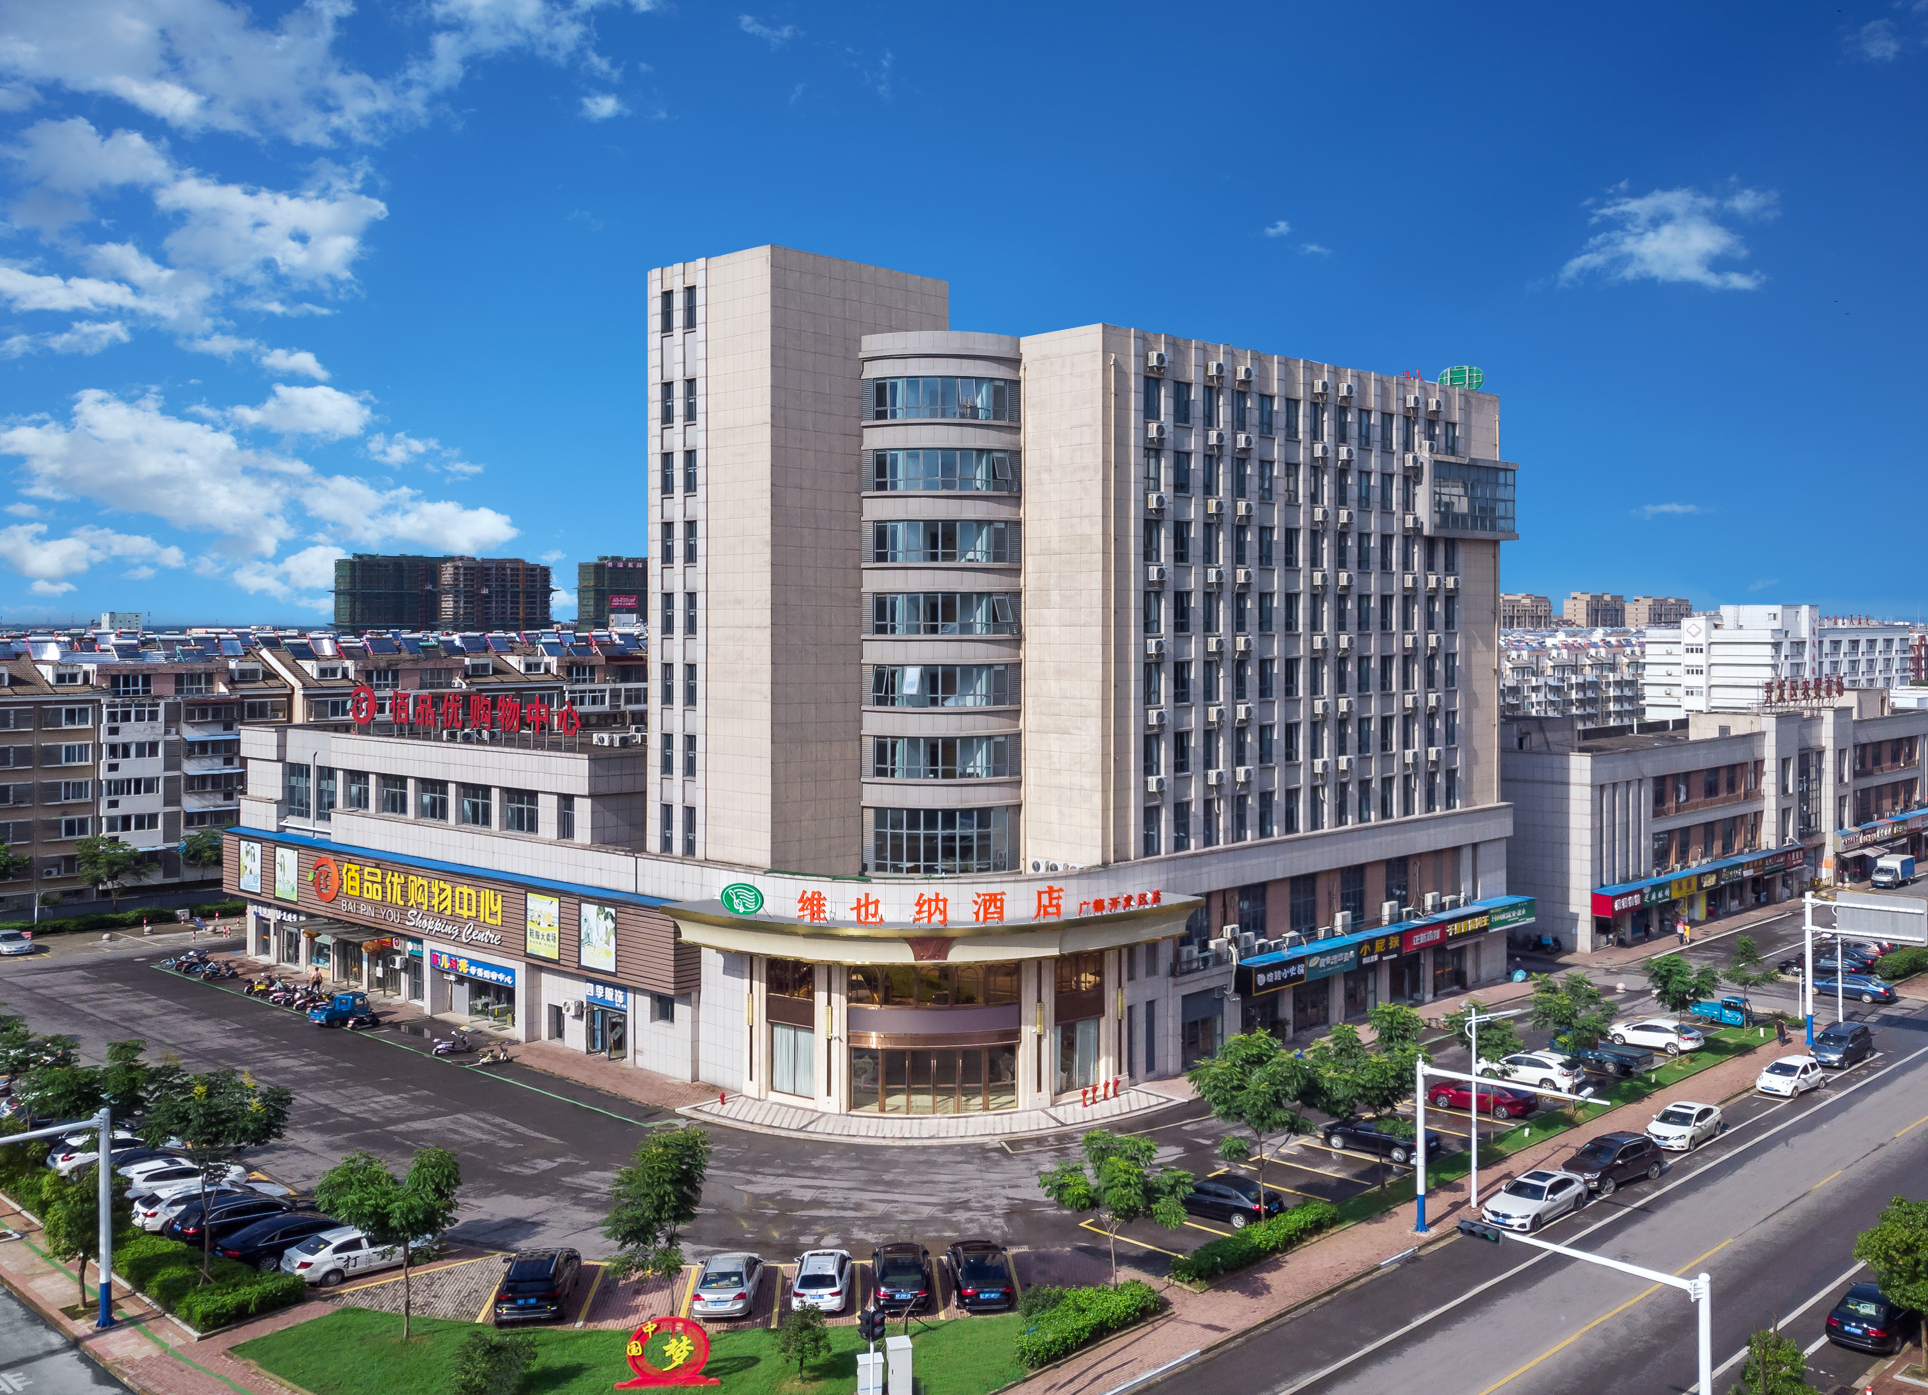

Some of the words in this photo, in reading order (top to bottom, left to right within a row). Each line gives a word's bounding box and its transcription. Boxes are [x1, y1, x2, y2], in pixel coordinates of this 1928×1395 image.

[390, 690, 582, 736] 佰品优购物中心
[342, 862, 502, 926] 佰品优购物中心
[797, 885, 1065, 926] 维也纳酒店
[341, 899, 356, 913] BAI
[360, 903, 375, 918] PIN
[380, 907, 400, 923] YOU
[405, 909, 459, 941] Shopping
[461, 922, 502, 945] Centre
[1360, 935, 1400, 956] 小屁孩
[586, 982, 624, 1004] 四季服饰
